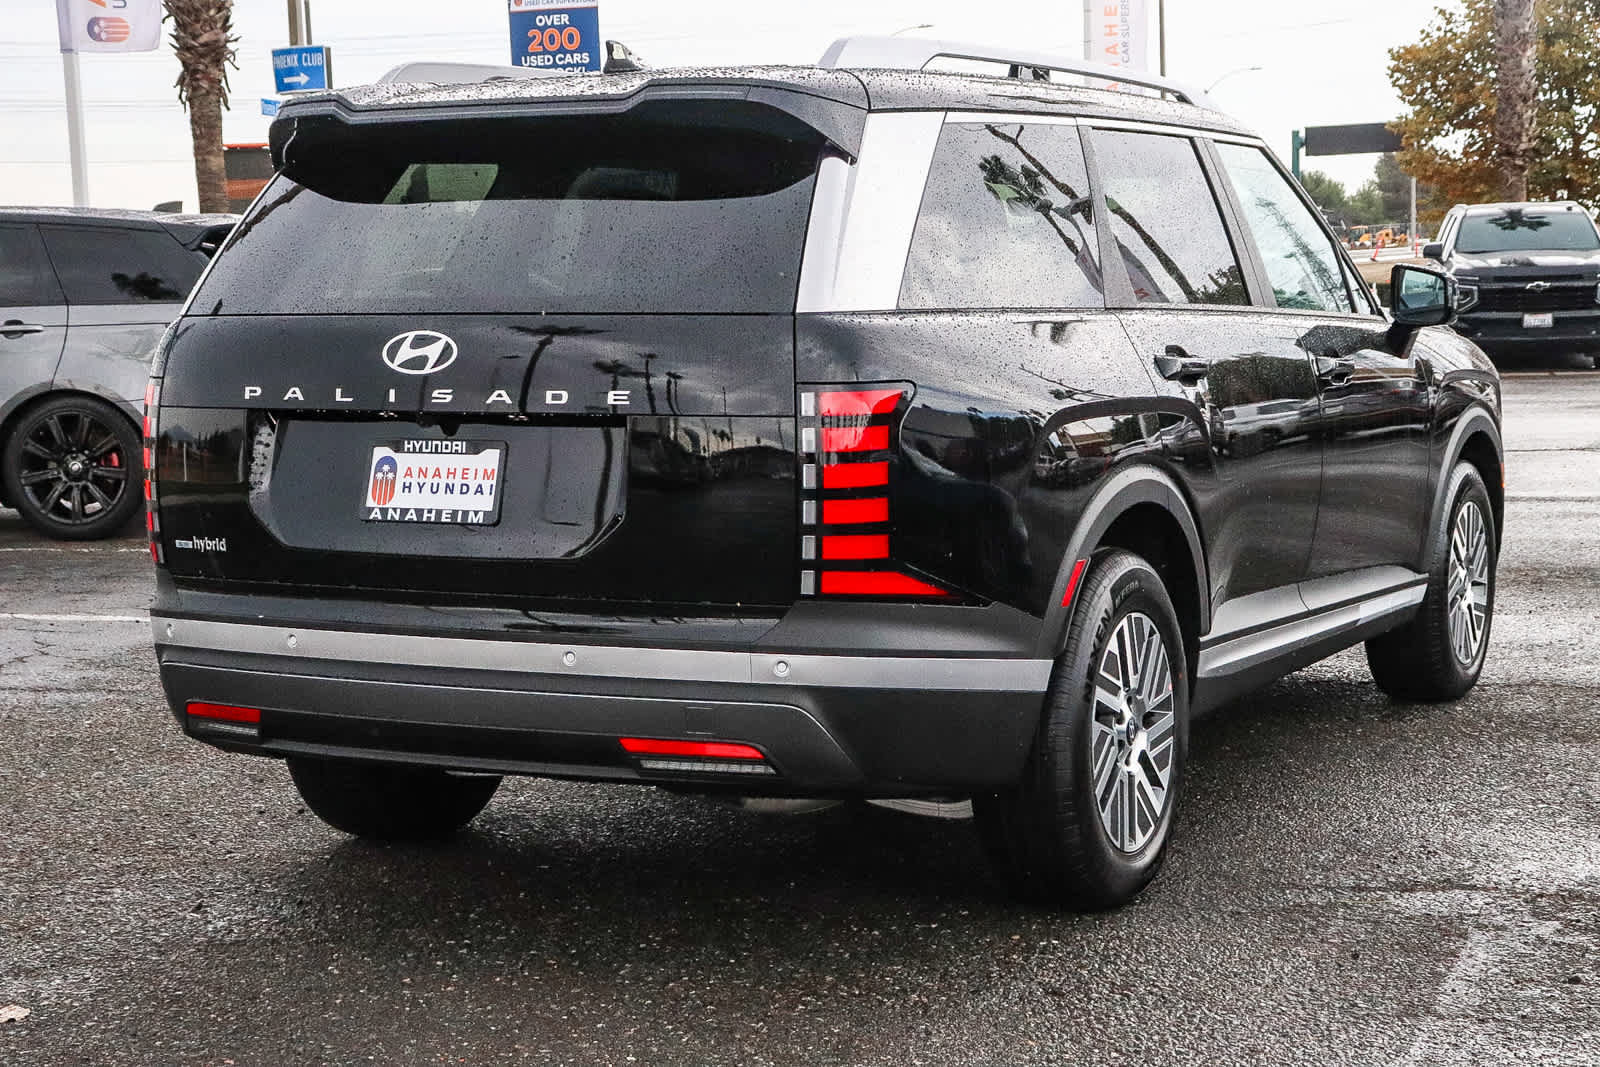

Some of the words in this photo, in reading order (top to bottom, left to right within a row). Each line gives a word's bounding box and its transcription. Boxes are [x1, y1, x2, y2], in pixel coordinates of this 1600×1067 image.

[536, 14, 570, 26] OVER
[528, 26, 581, 52] 200
[521, 54, 553, 66] USED
[555, 52, 590, 65] CARS
[1120, 41, 1130, 63] CAR
[273, 53, 299, 69] PHOENIX
[302, 52, 323, 67] CLUB
[244, 386, 632, 406] PALISADE
[404, 440, 467, 453] HYUNDAI
[403, 466, 496, 480] ANAHEIM
[402, 481, 494, 496] HYUNDAI
[369, 507, 484, 523] ANAHEIM
[193, 535, 227, 552] hybrid
